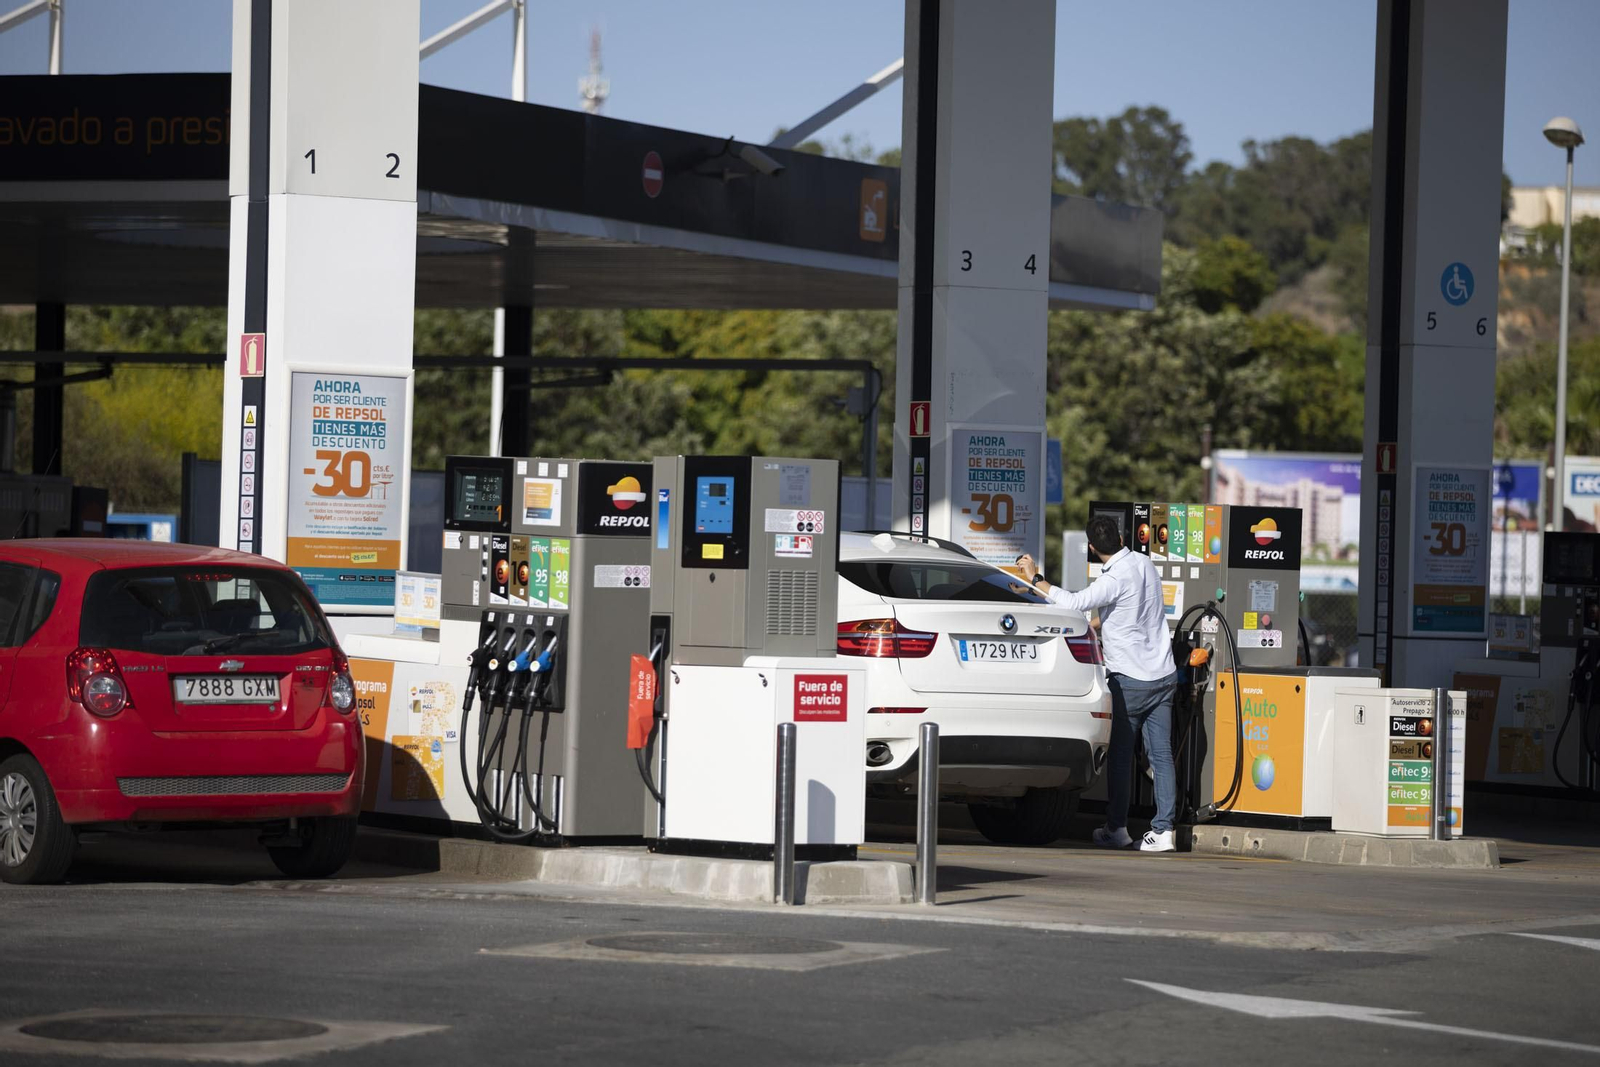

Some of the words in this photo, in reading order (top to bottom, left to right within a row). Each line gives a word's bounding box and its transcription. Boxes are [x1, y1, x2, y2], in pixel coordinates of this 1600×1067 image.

[114, 117, 134, 145] a
[304, 149, 316, 174] 1
[386, 153, 400, 178] 2
[961, 250, 972, 272] 3
[1024, 254, 1036, 275] 4
[1427, 312, 1436, 330] 5
[1476, 318, 1487, 336] 6
[314, 380, 361, 393] AHORA
[313, 394, 331, 404] POR
[333, 395, 350, 405] SER
[352, 396, 387, 406] CLIENTE
[313, 406, 330, 418] DE
[336, 407, 386, 421] REPSOL
[314, 422, 356, 434] TIENES
[361, 422, 385, 436] MÁS
[312, 436, 385, 449] DESCUENTO
[969, 436, 1005, 446] AHORA
[998, 449, 1026, 457] CLIENTE
[969, 457, 982, 467] DE
[986, 458, 1025, 468] REPSOL
[304, 450, 371, 498] -30
[970, 471, 1002, 480] TIENES
[1005, 470, 1024, 480] MÁS
[1430, 473, 1460, 482] AHORA
[968, 482, 1025, 492] DESCUENTO
[1429, 491, 1440, 500] DE
[1443, 492, 1475, 501] REPSOL
[496, 505, 502, 522] 1
[962, 493, 1014, 532] -30
[1431, 503, 1456, 512] TIENES
[600, 515, 650, 528] REPSOL
[1429, 513, 1476, 522] DESCUENTO
[1174, 530, 1184, 541] 95
[1192, 531, 1203, 542] 98
[1424, 523, 1466, 556] -30
[493, 541, 507, 549] Diesel
[513, 543, 526, 551] Diesel
[532, 544, 548, 552] efitec
[1244, 550, 1285, 560] REPSOL
[535, 569, 547, 583] 95
[556, 570, 568, 584] 98
[972, 643, 1006, 658] 1729
[1011, 644, 1037, 659] KFJ
[638, 670, 644, 679] de
[186, 678, 234, 697] 7888
[243, 679, 276, 696] GXM
[799, 681, 827, 692] Fuera
[830, 681, 842, 692] de
[801, 693, 841, 705] servicio
[1243, 698, 1277, 718] Auto
[1242, 720, 1268, 741] Gas
[1393, 722, 1416, 731] Diesel
[1392, 745, 1414, 754] Diesel
[1392, 767, 1419, 777] efitec
[1391, 789, 1418, 799] efitec
